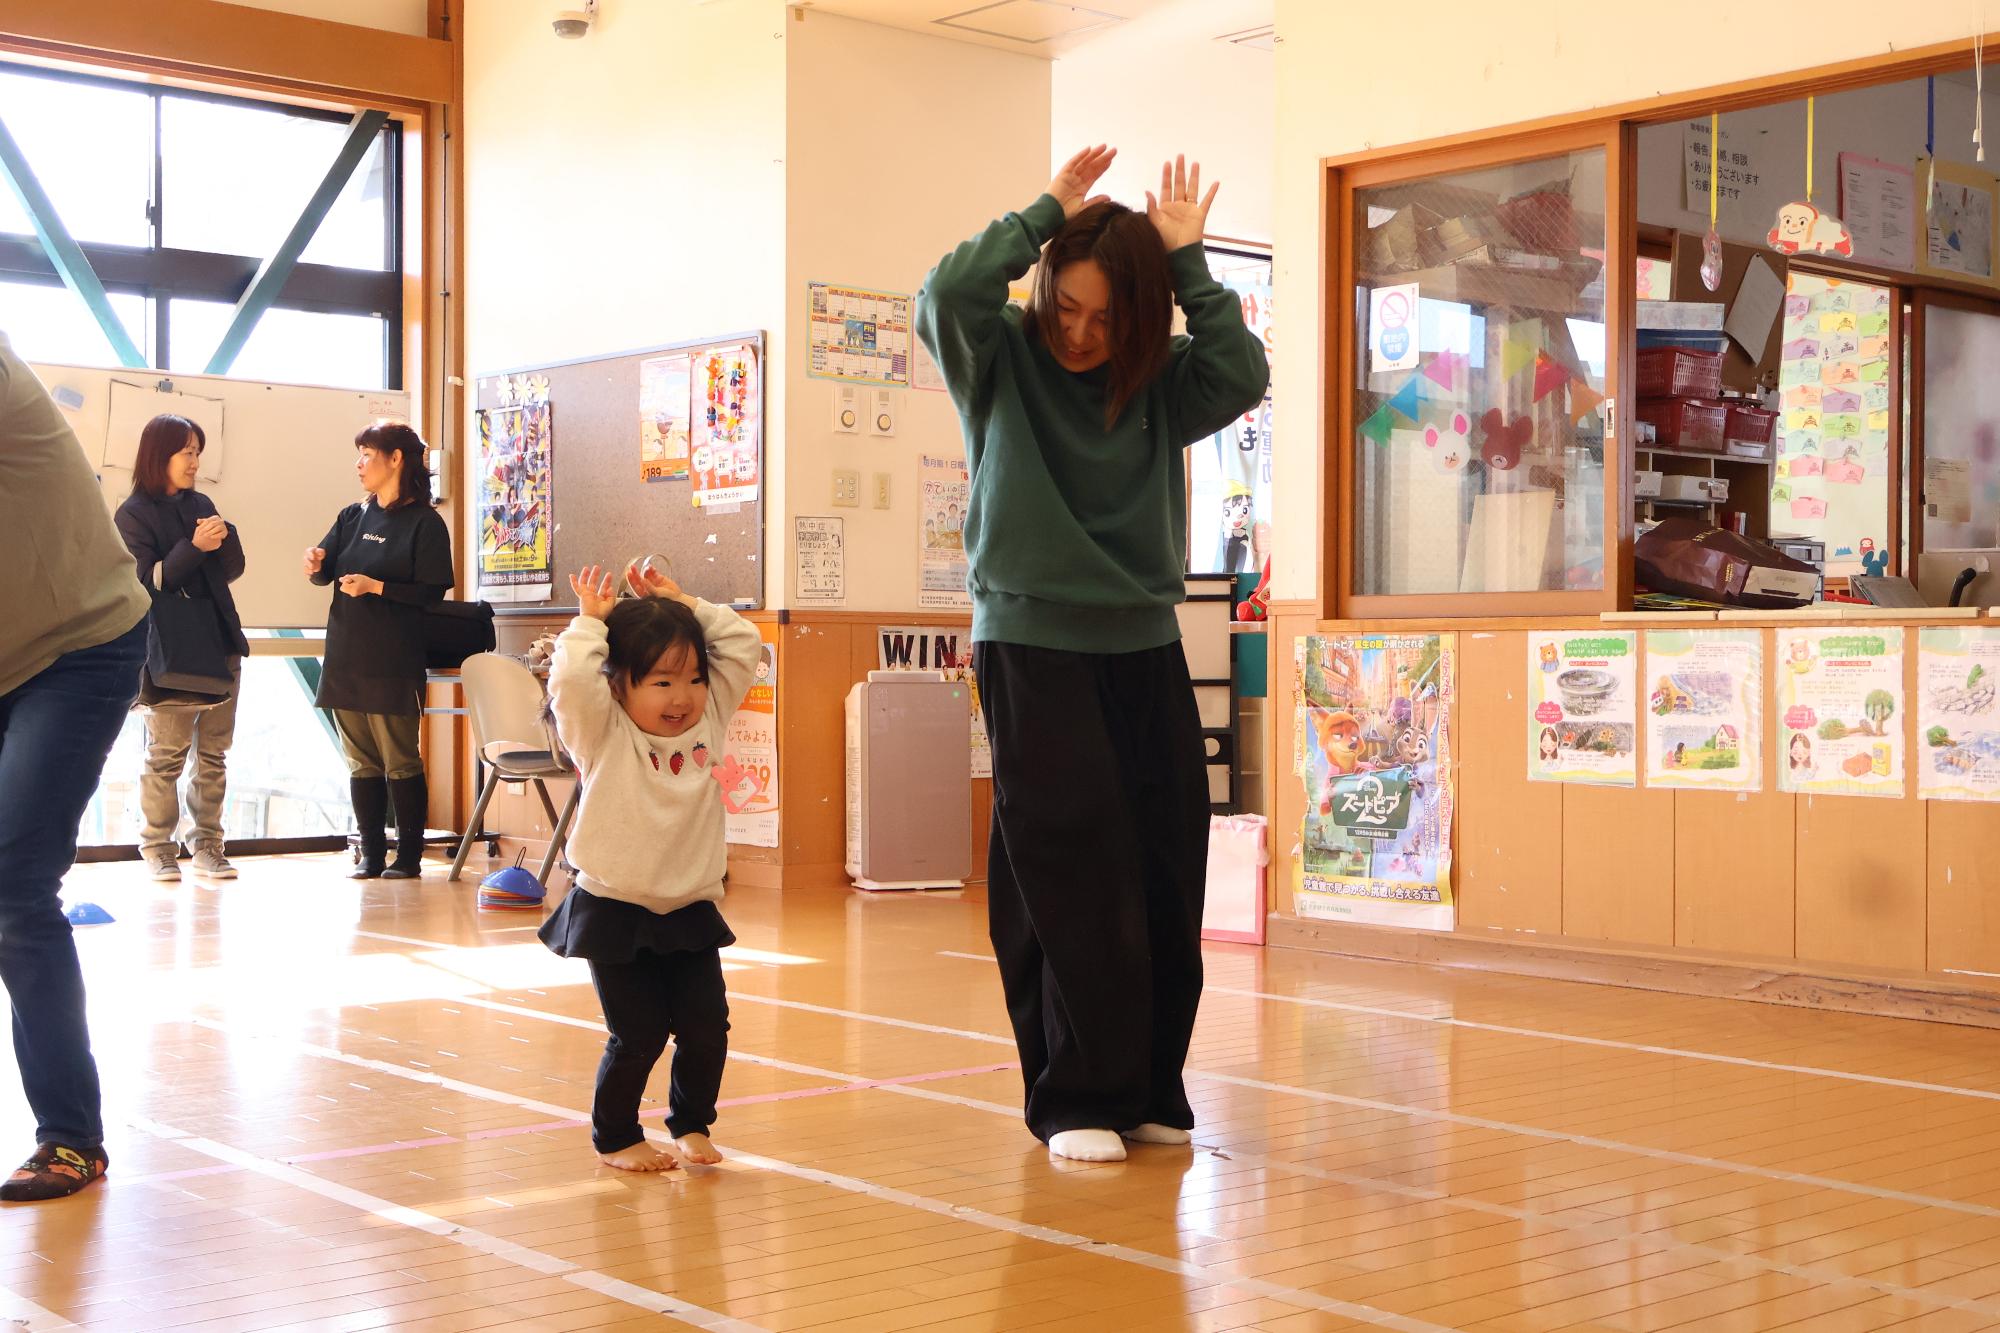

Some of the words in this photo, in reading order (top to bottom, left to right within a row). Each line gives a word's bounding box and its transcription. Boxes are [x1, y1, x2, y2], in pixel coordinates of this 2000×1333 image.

[1689, 142, 1748, 167] ・報告、絡、相談
[1340, 791, 1402, 815] ズートピア
